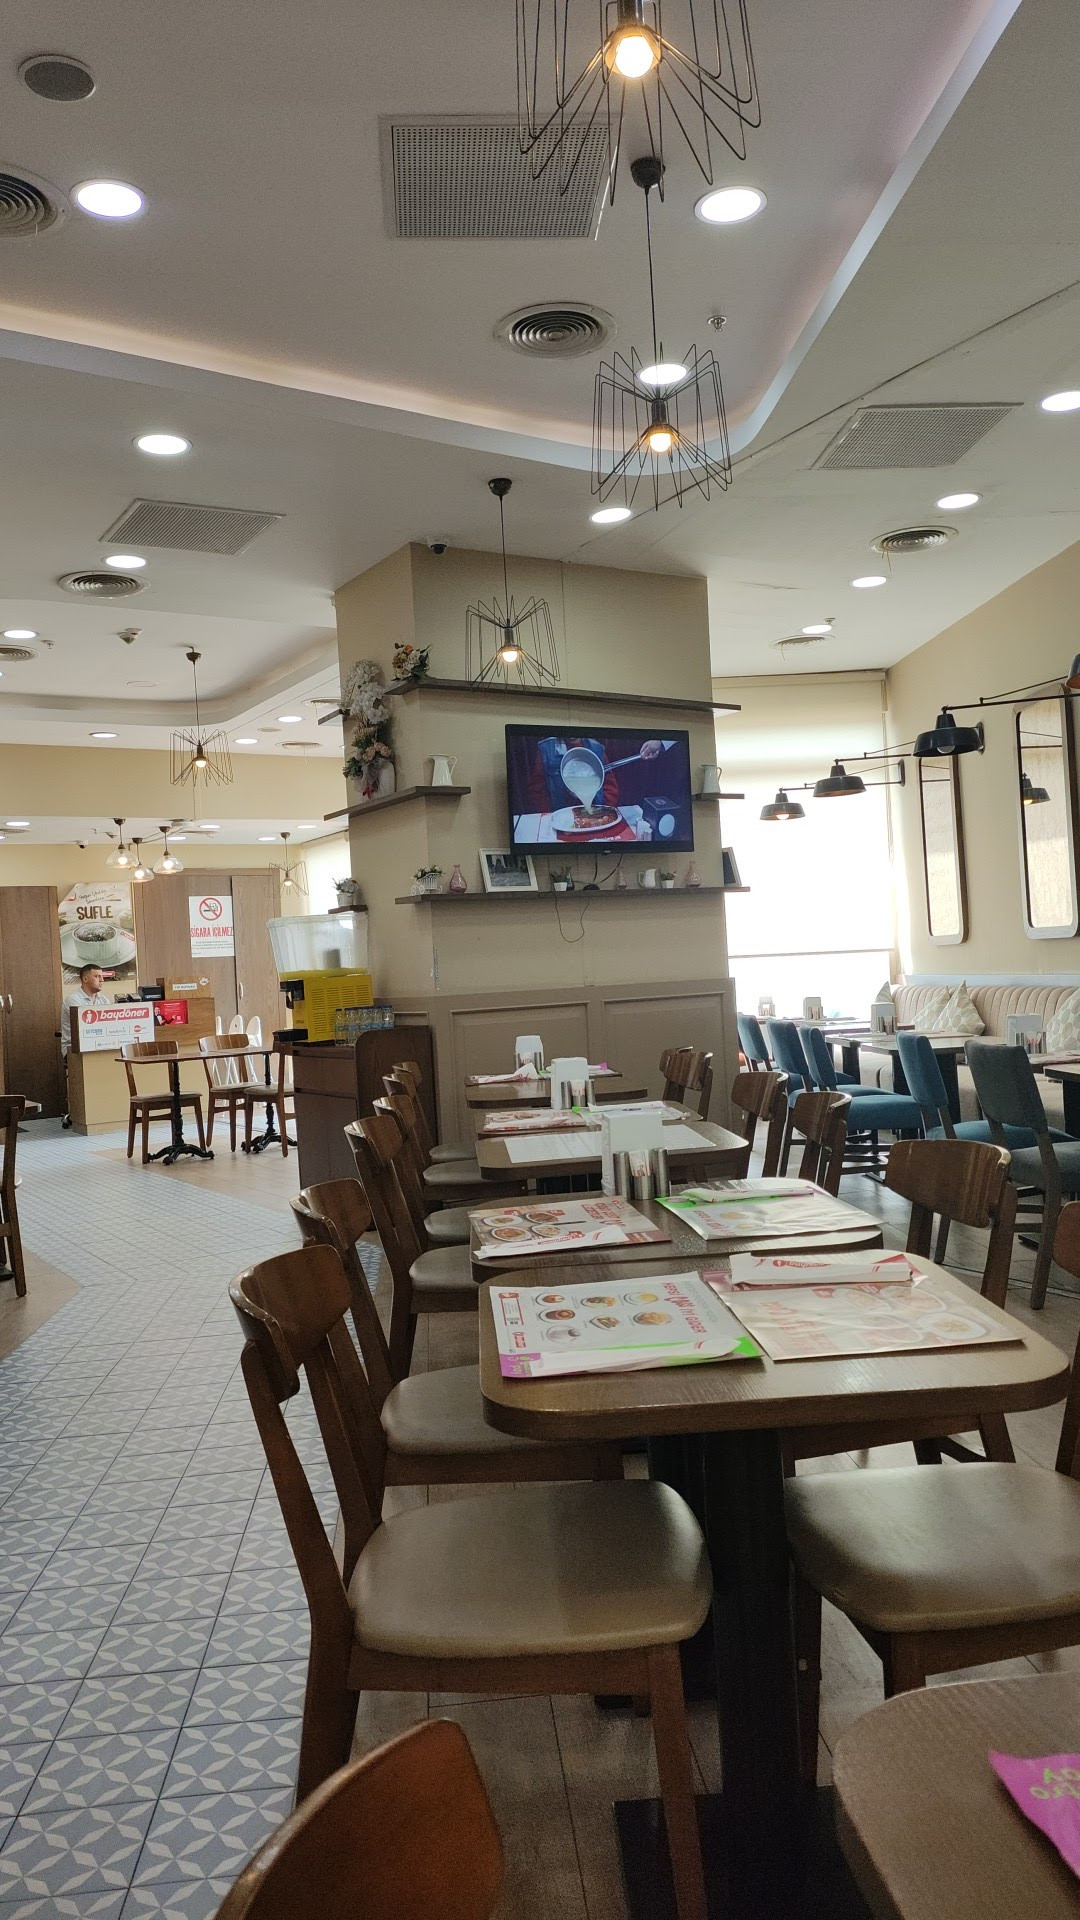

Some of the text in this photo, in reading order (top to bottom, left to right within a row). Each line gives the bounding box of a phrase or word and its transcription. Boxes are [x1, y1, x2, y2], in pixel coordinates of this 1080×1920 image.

[76, 905, 113, 920] SUFLE
[190, 925, 211, 938] SİGARA
[100, 1008, 148, 1021] baydöner
